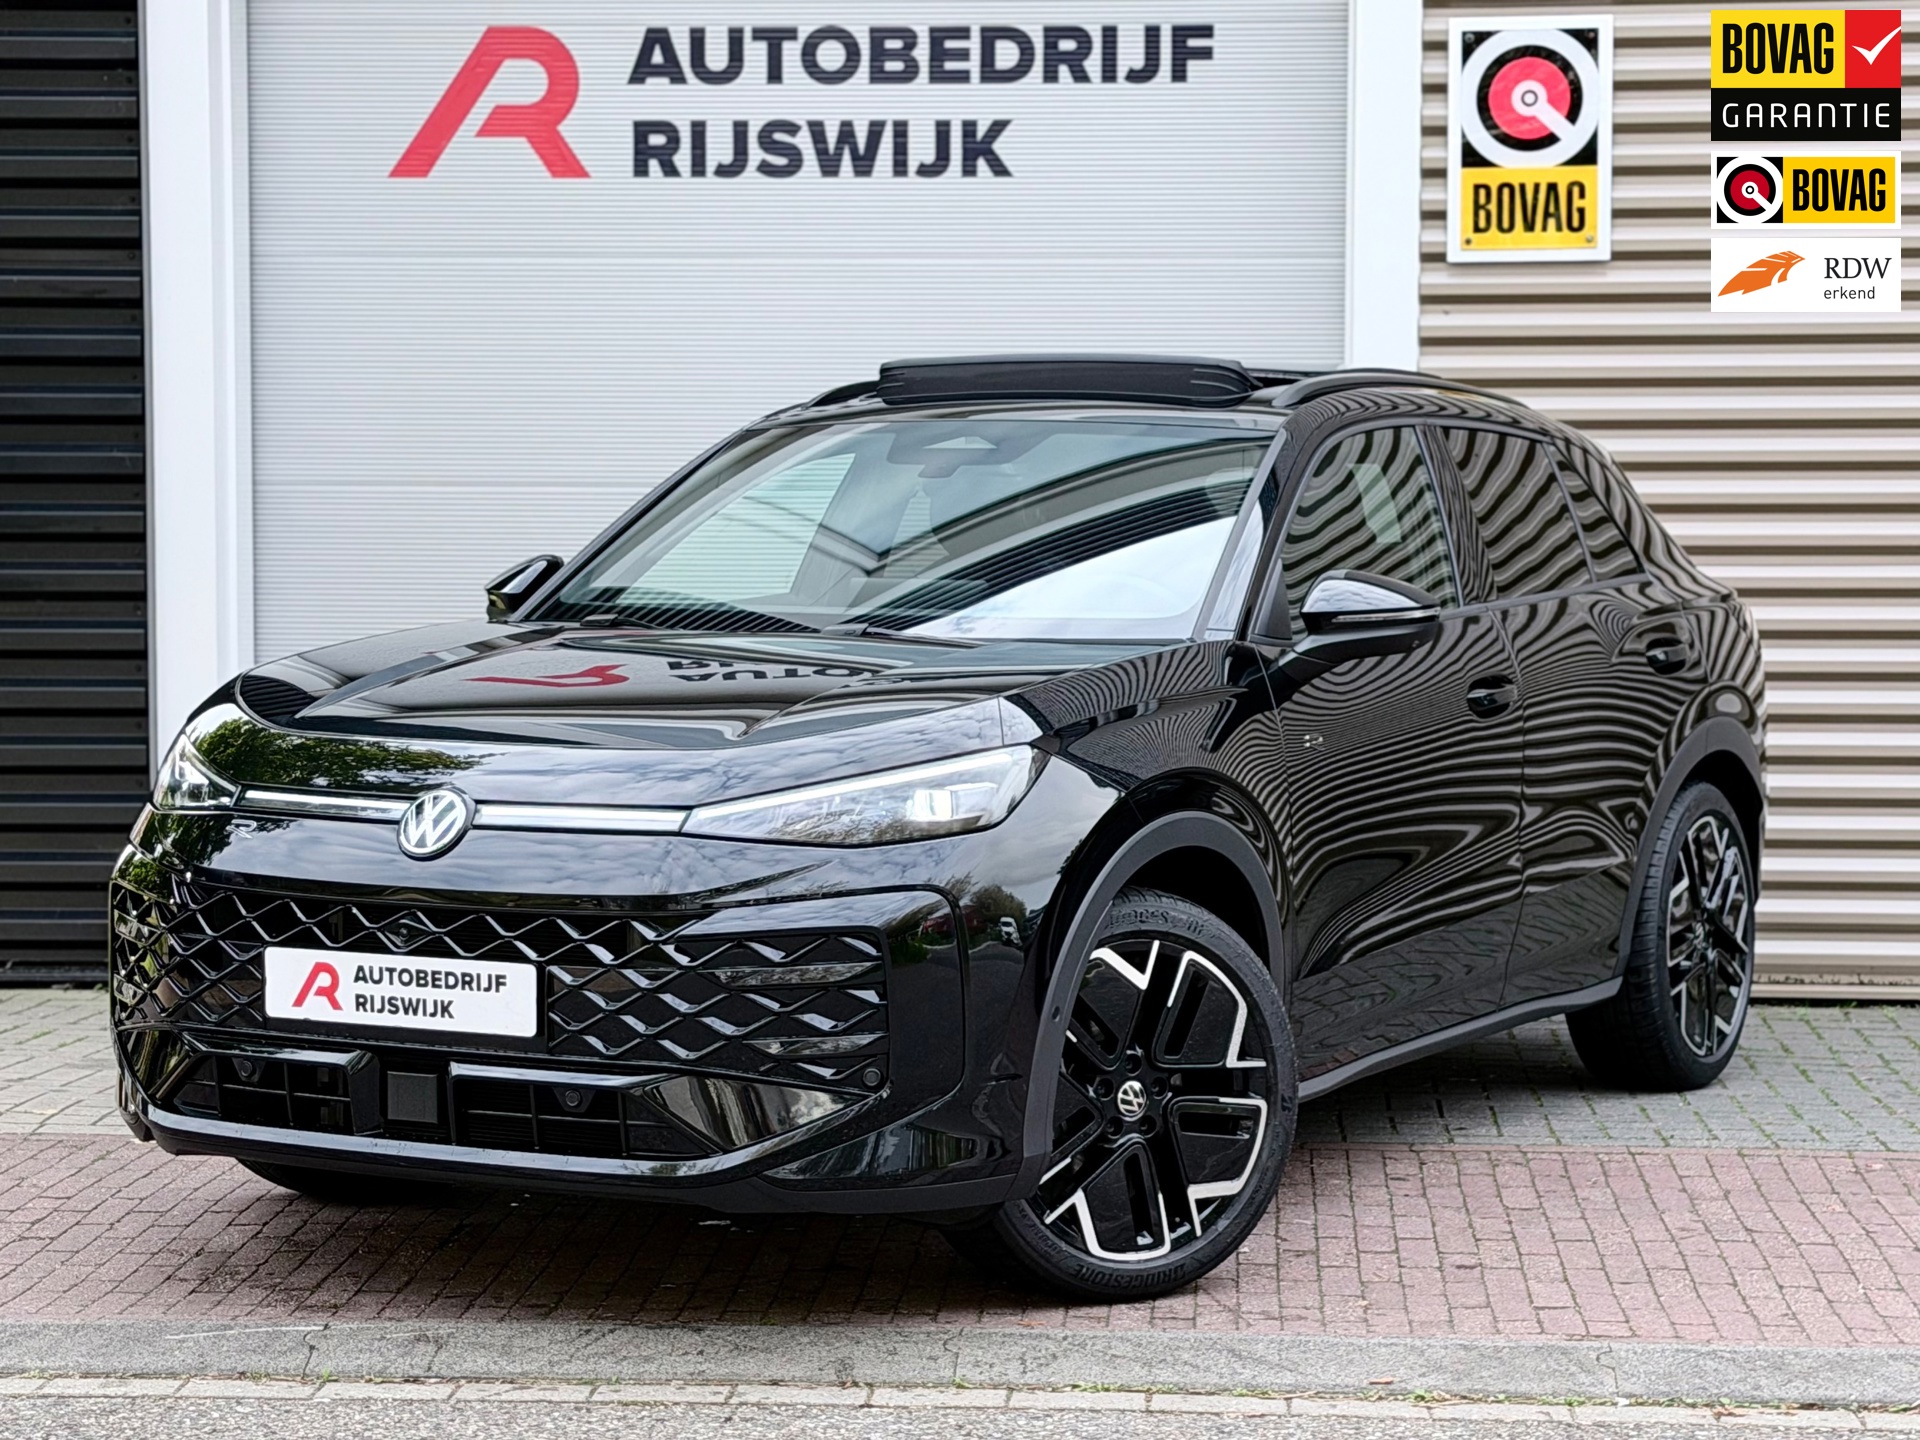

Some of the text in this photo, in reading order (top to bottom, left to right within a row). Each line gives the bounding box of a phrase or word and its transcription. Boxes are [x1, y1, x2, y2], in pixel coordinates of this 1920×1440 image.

[628, 24, 1214, 85] AUTOBEDRIJF
[632, 119, 1012, 178] RIJSWIJK
[1472, 181, 1586, 234] BOVAG
[353, 964, 508, 994] AUTOBEDRIJF
[355, 993, 455, 1019] RIJSWIJK
